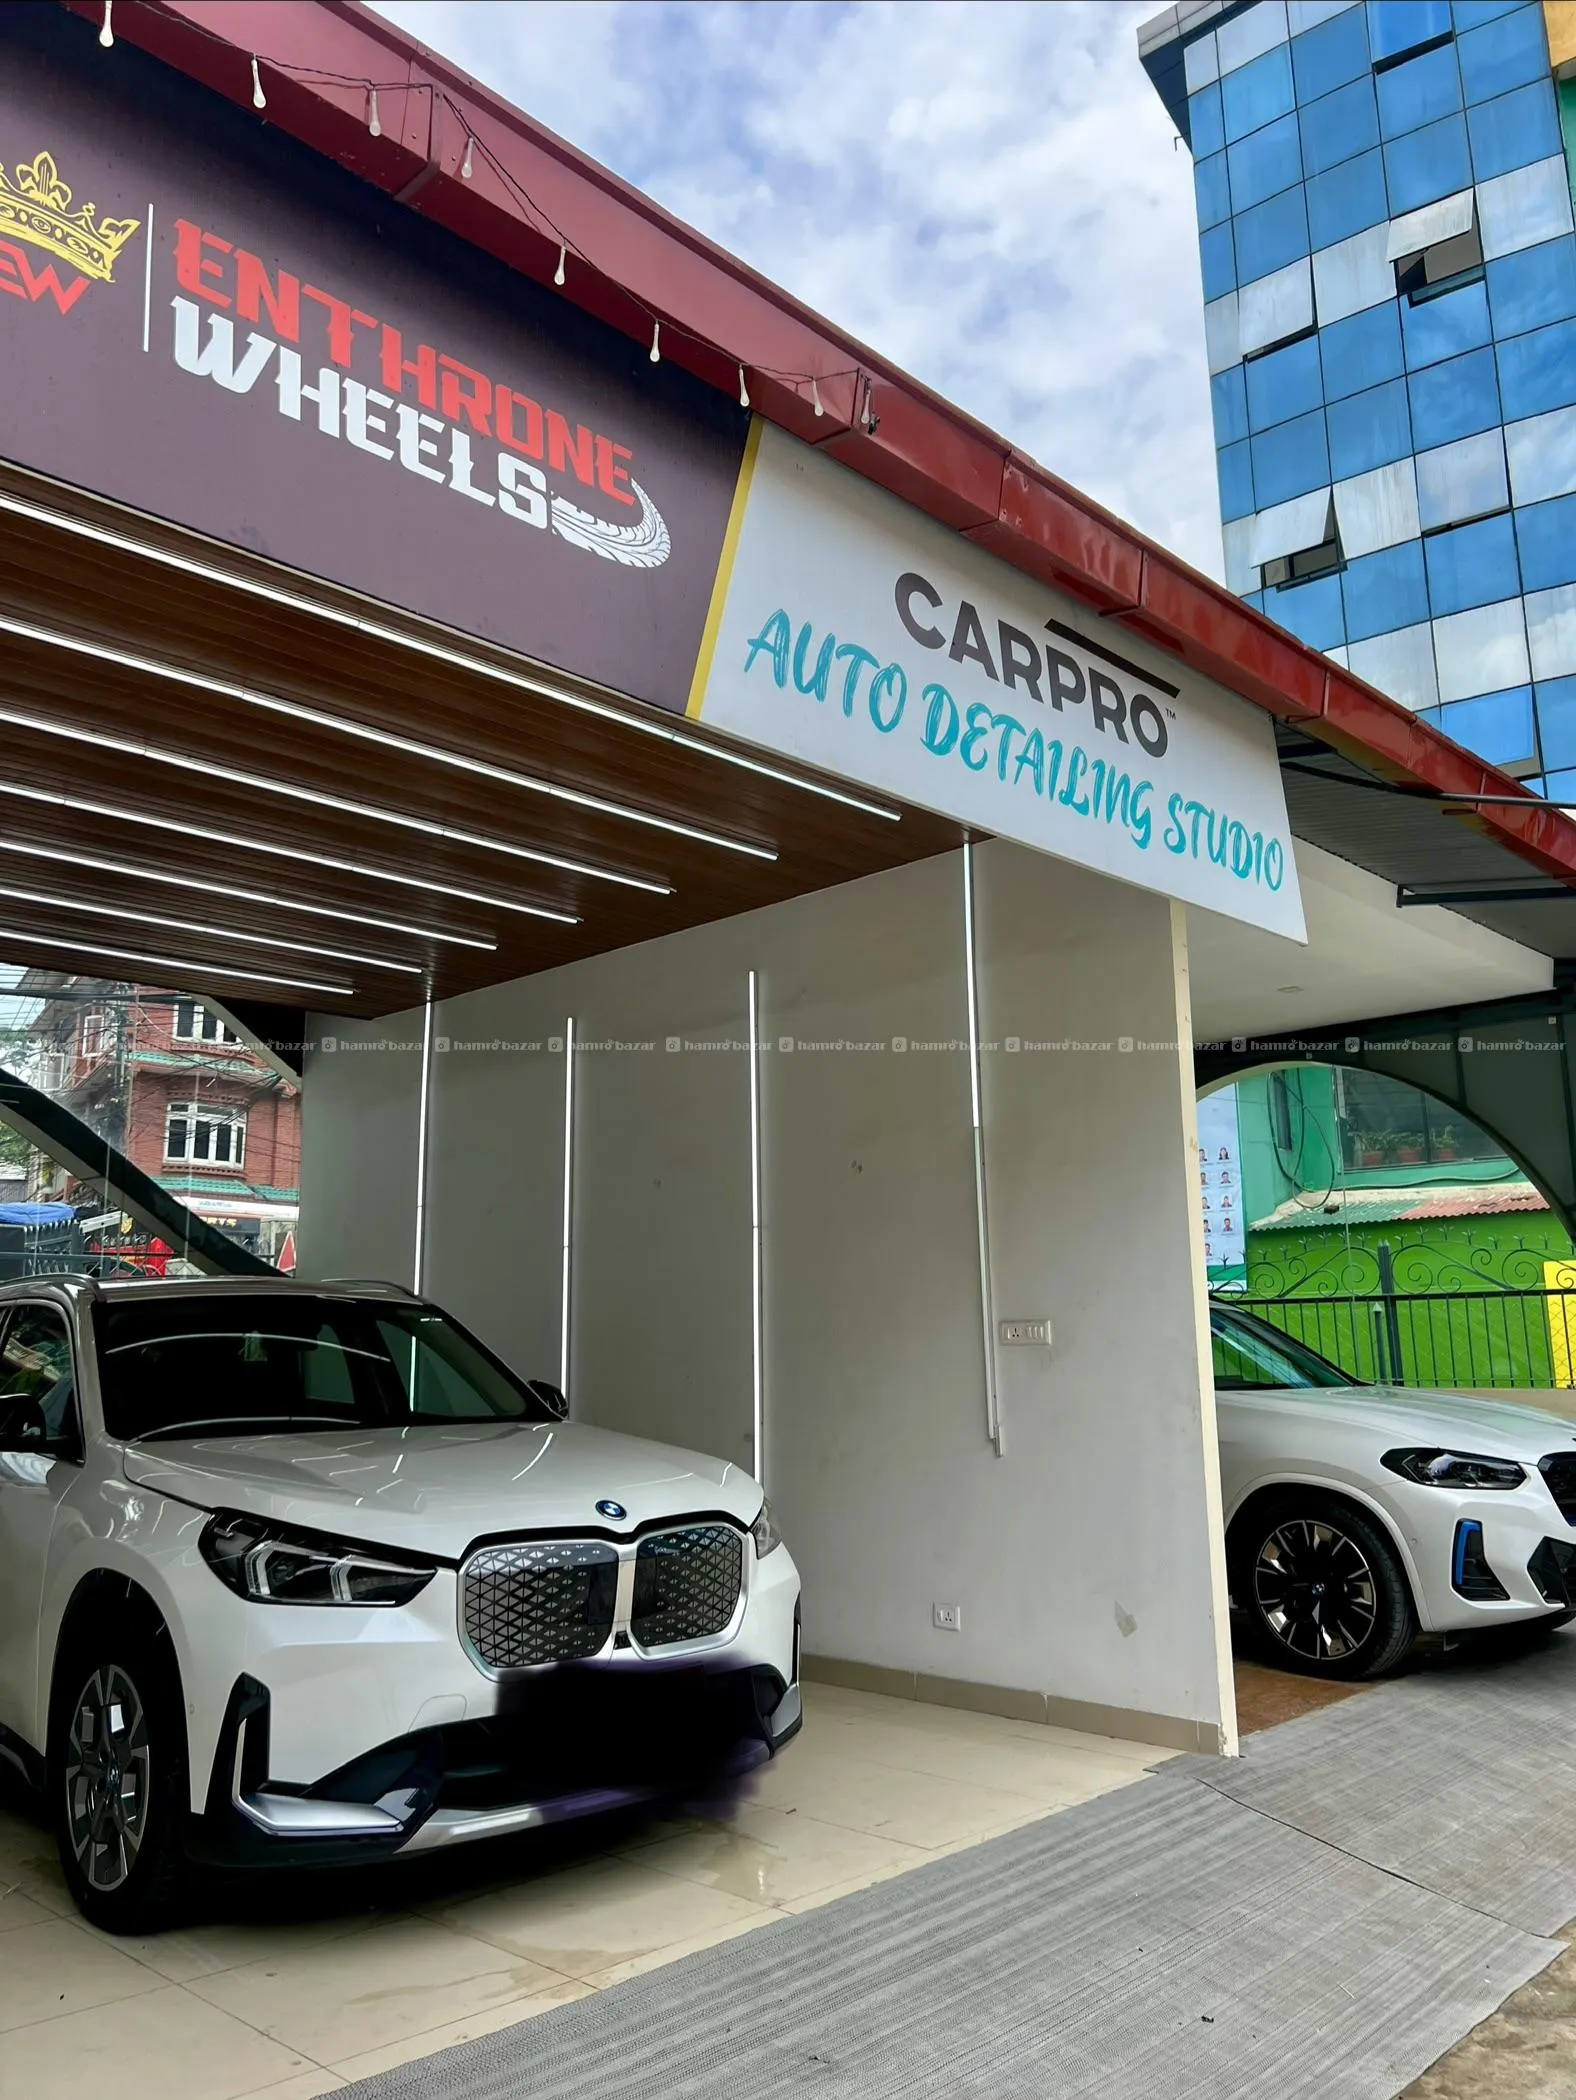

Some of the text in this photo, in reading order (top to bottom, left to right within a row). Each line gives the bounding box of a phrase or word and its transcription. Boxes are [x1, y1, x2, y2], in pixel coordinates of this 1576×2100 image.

[170, 294, 549, 536] WHEELS
[174, 218, 637, 506] ENTHRONE
[744, 608, 1285, 893] AUTO DETAILING STUDIO
[894, 571, 1169, 758] CARPRO
